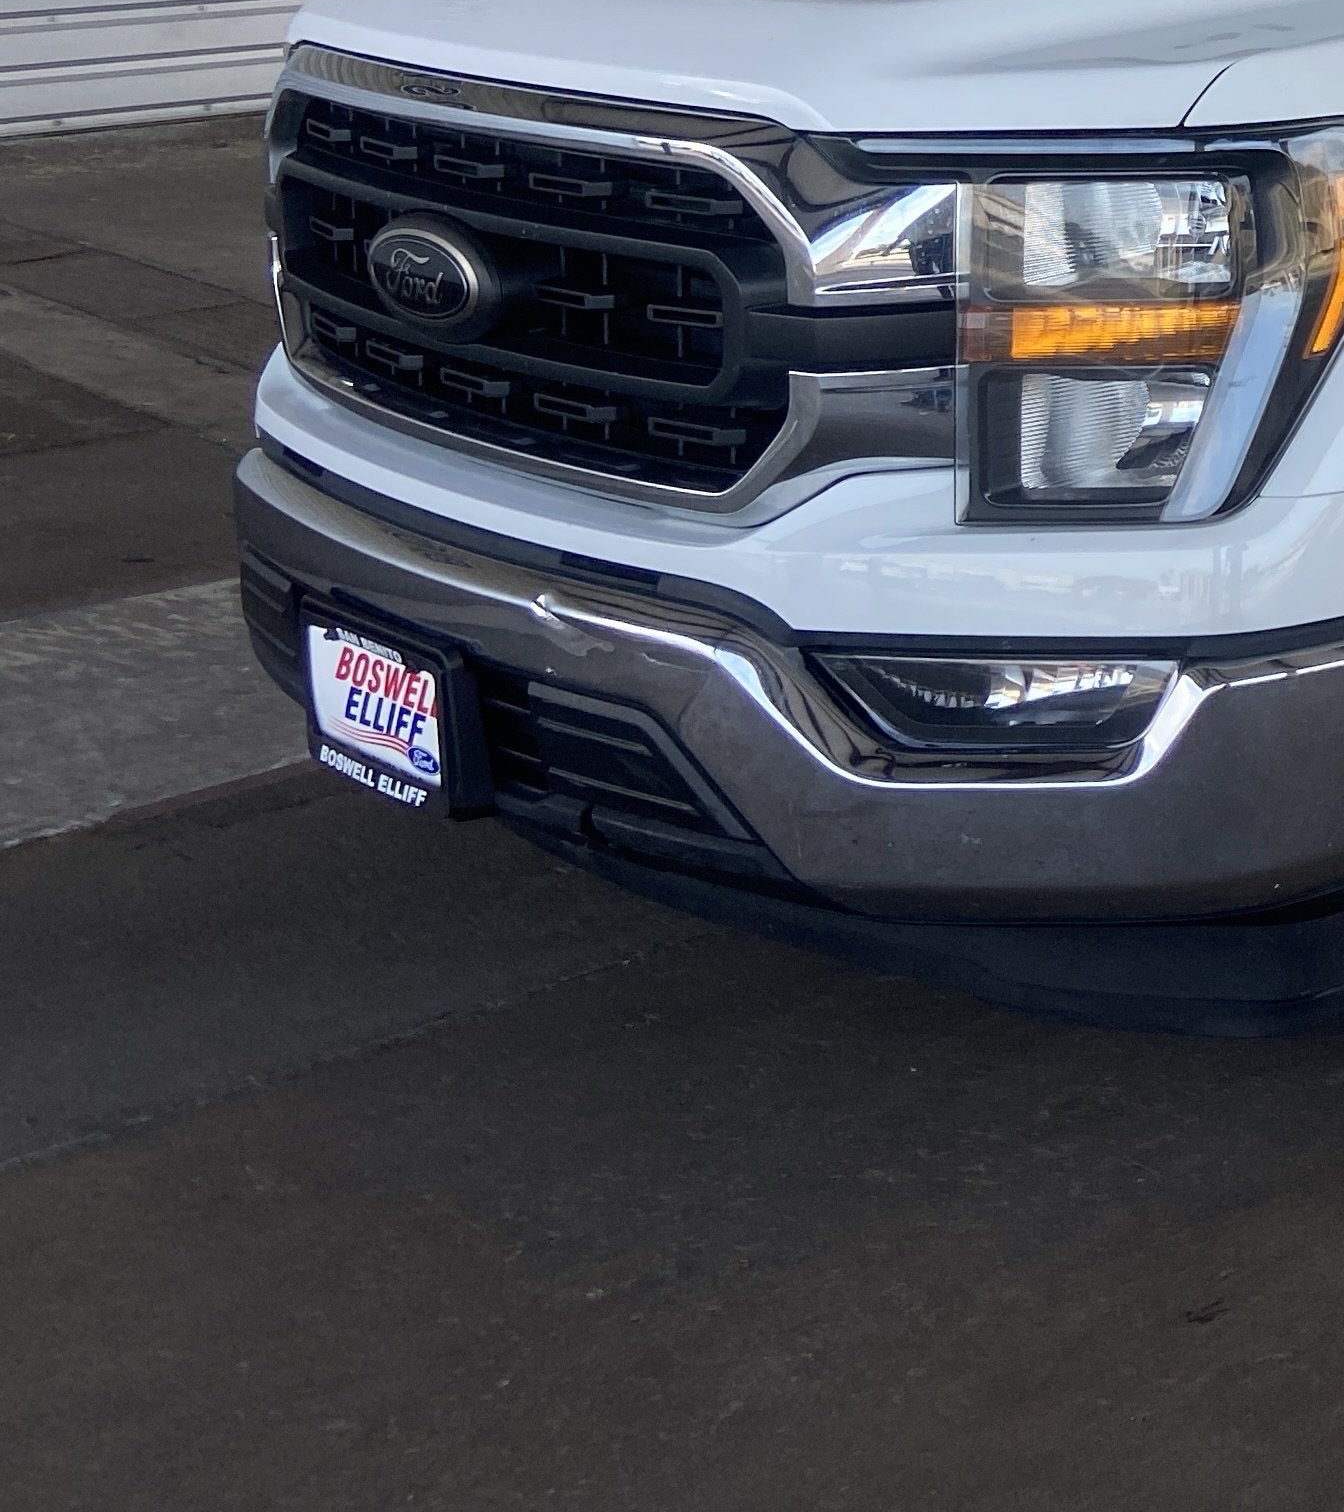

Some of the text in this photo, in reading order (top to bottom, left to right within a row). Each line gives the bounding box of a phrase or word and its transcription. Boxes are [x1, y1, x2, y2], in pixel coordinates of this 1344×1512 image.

[386, 247, 444, 305] Ford
[345, 686, 427, 745] ELLIFF
[319, 745, 428, 807] BOSWELL ELLIFF
